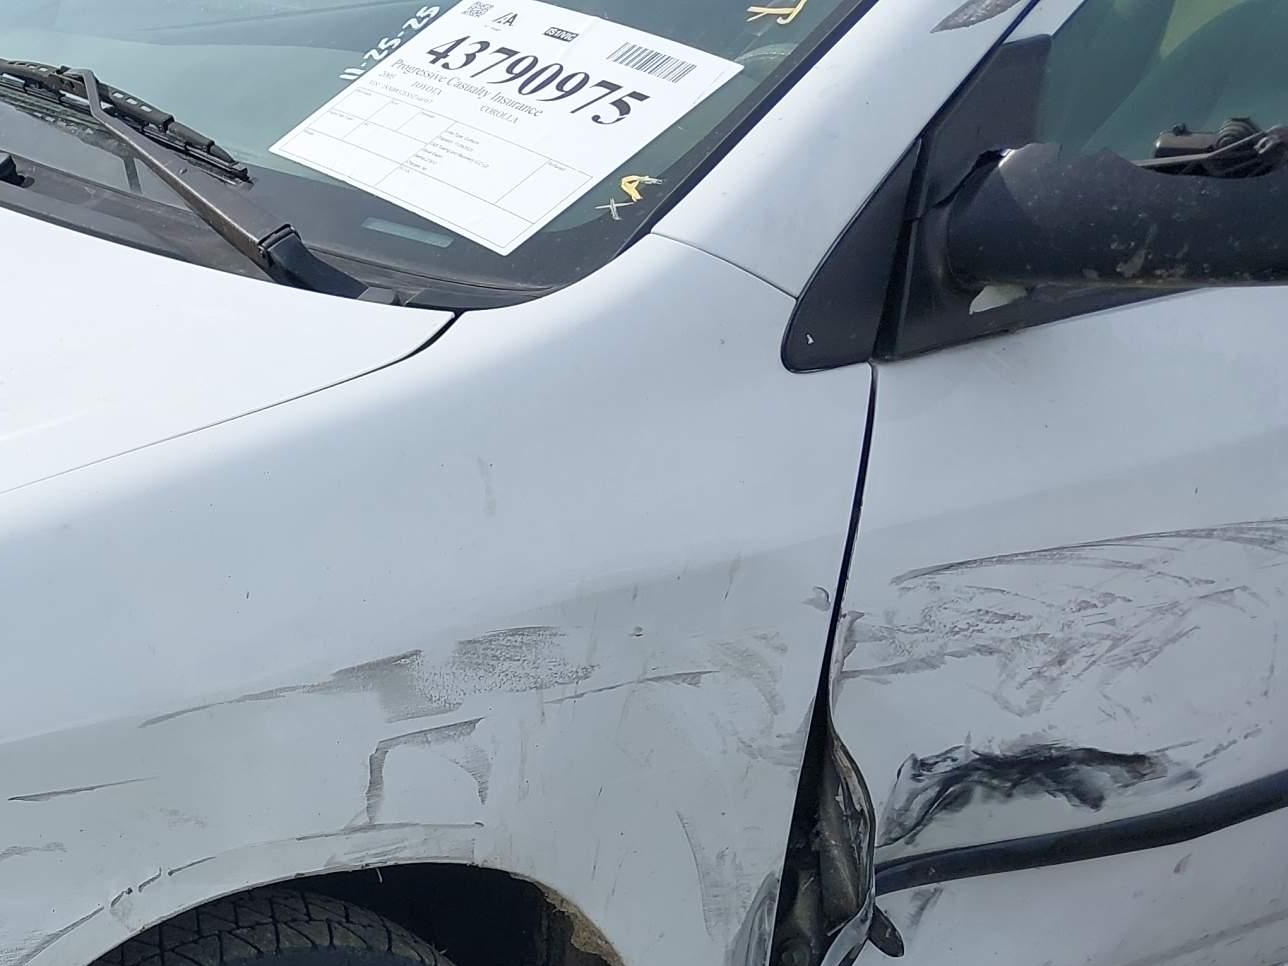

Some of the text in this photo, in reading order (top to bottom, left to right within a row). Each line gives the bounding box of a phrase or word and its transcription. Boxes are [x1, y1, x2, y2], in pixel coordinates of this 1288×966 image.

[391, 58, 447, 83] Progressive
[446, 76, 491, 99] Casualty
[491, 92, 544, 117] Insurance
[425, 36, 650, 125] 43790975
[480, 105, 519, 124] COROLLA
